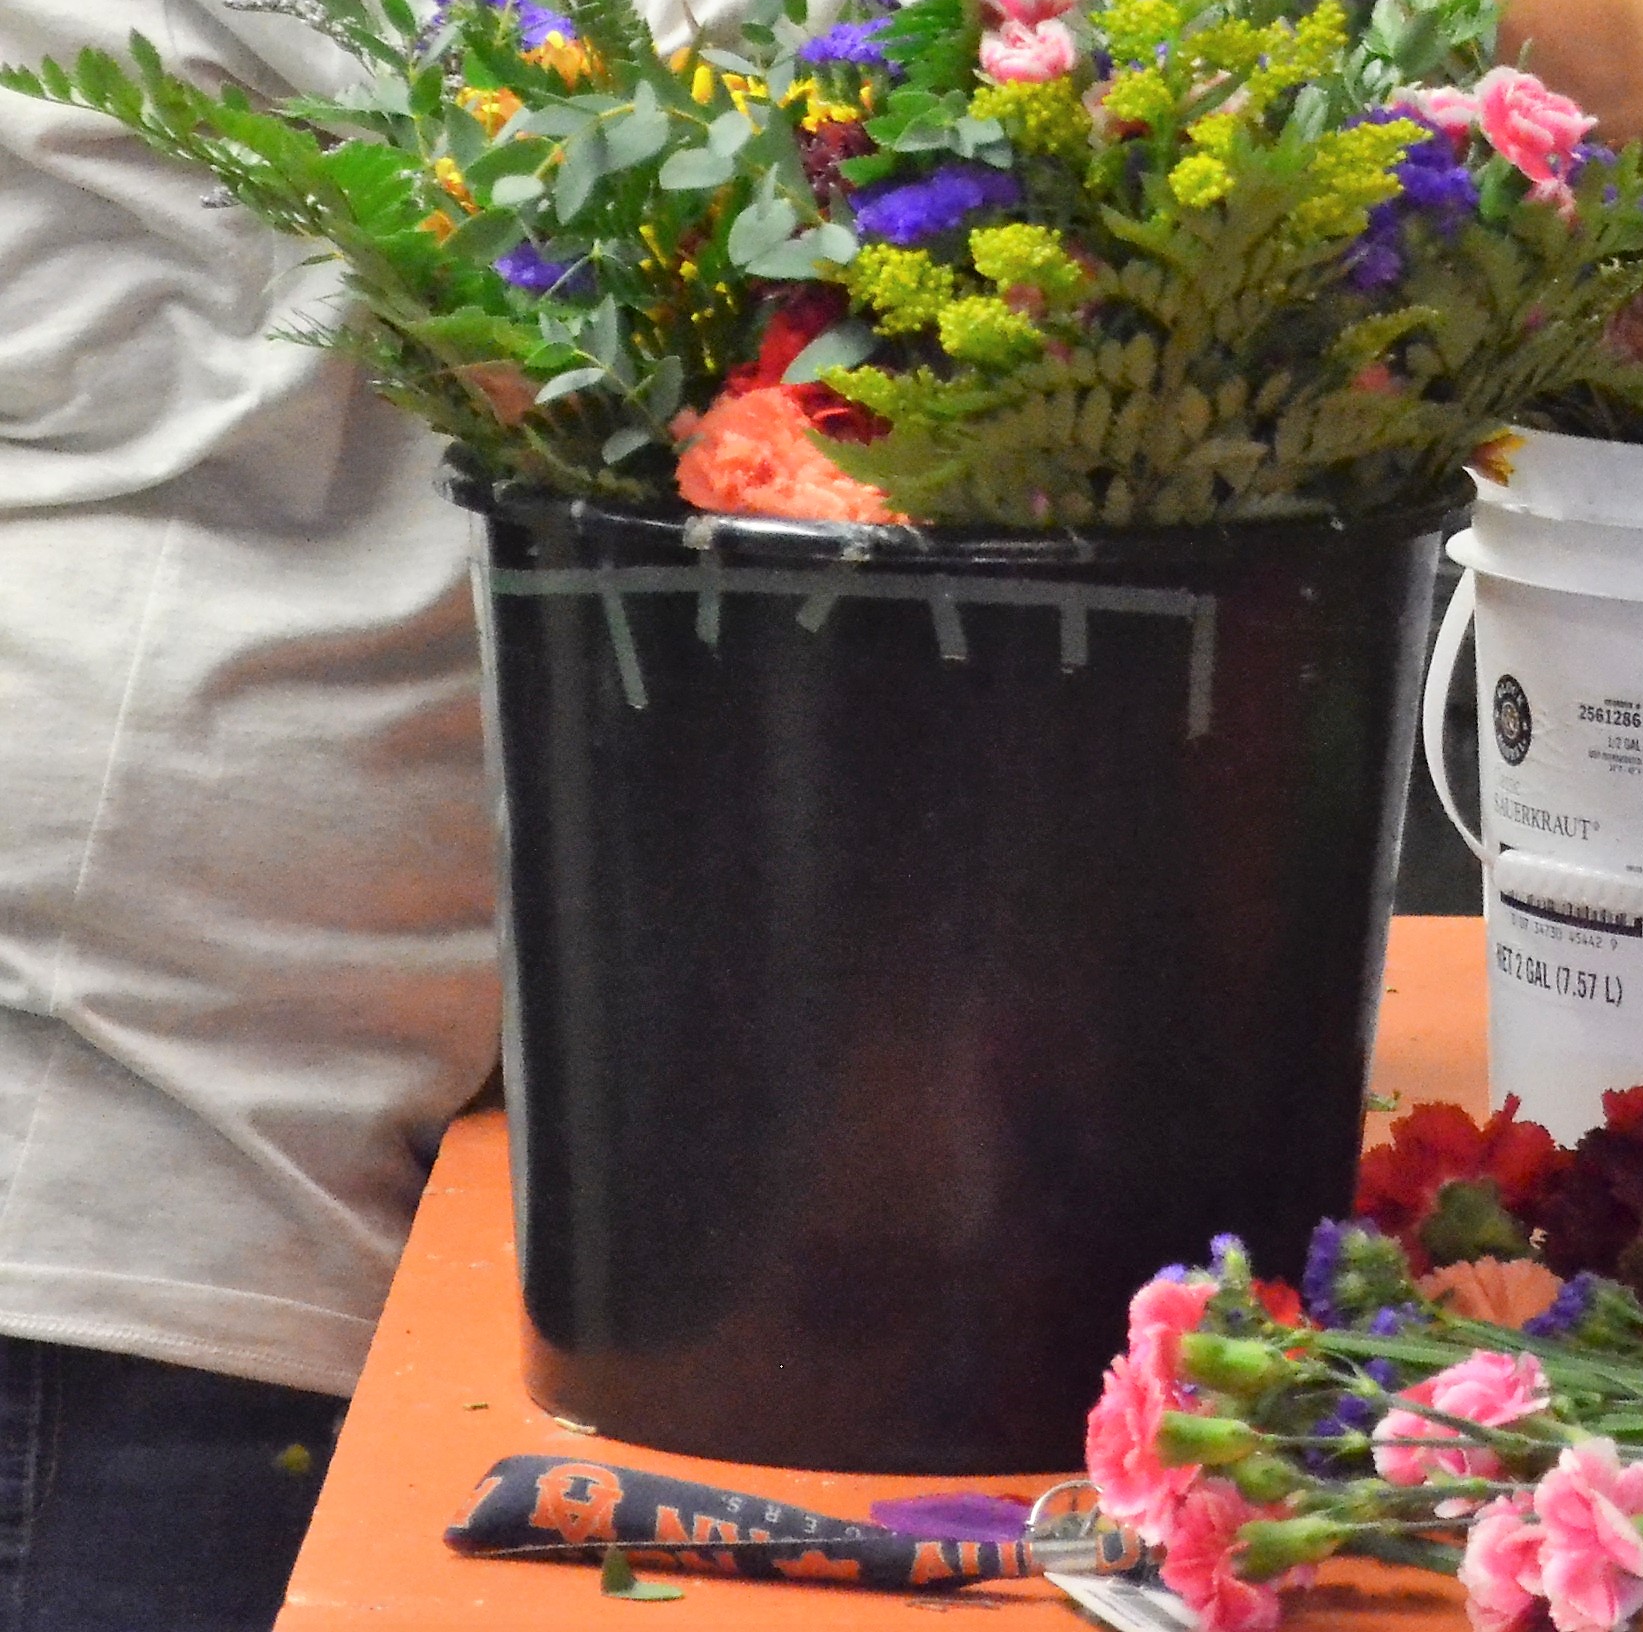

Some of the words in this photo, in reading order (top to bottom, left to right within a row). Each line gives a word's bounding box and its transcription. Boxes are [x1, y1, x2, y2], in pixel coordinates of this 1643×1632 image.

[1579, 704, 1642, 728] 2561286
[1494, 792, 1591, 840] SAUERKRAUT
[1516, 953, 1522, 980] 2
[1526, 956, 1551, 990] GAL
[1556, 965, 1597, 999] (7.57
[1605, 974, 1623, 1008] L)
